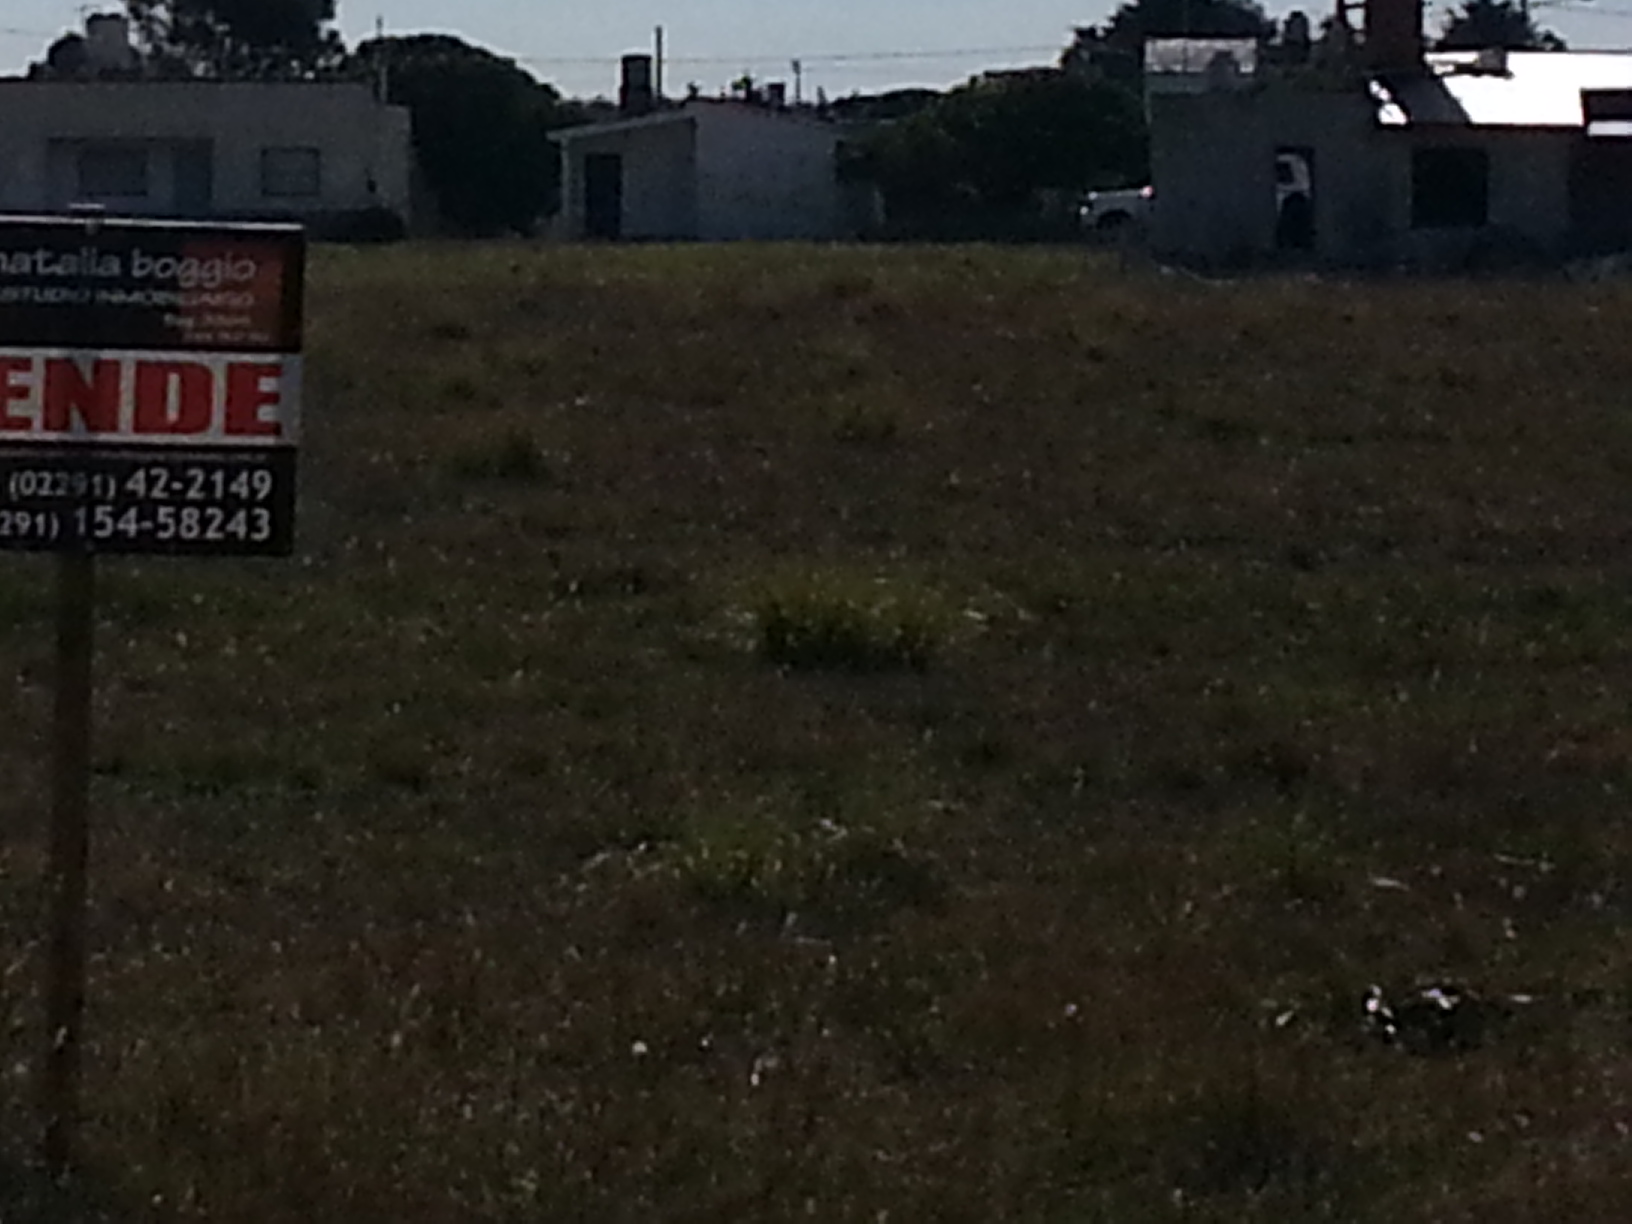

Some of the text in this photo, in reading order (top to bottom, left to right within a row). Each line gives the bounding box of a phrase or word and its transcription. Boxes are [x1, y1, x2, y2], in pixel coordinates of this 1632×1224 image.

[132, 250, 256, 287] boggio
[10, 470, 116, 499] (02291)
[126, 469, 272, 501] 42-2149
[76, 508, 272, 540] 154-58243
